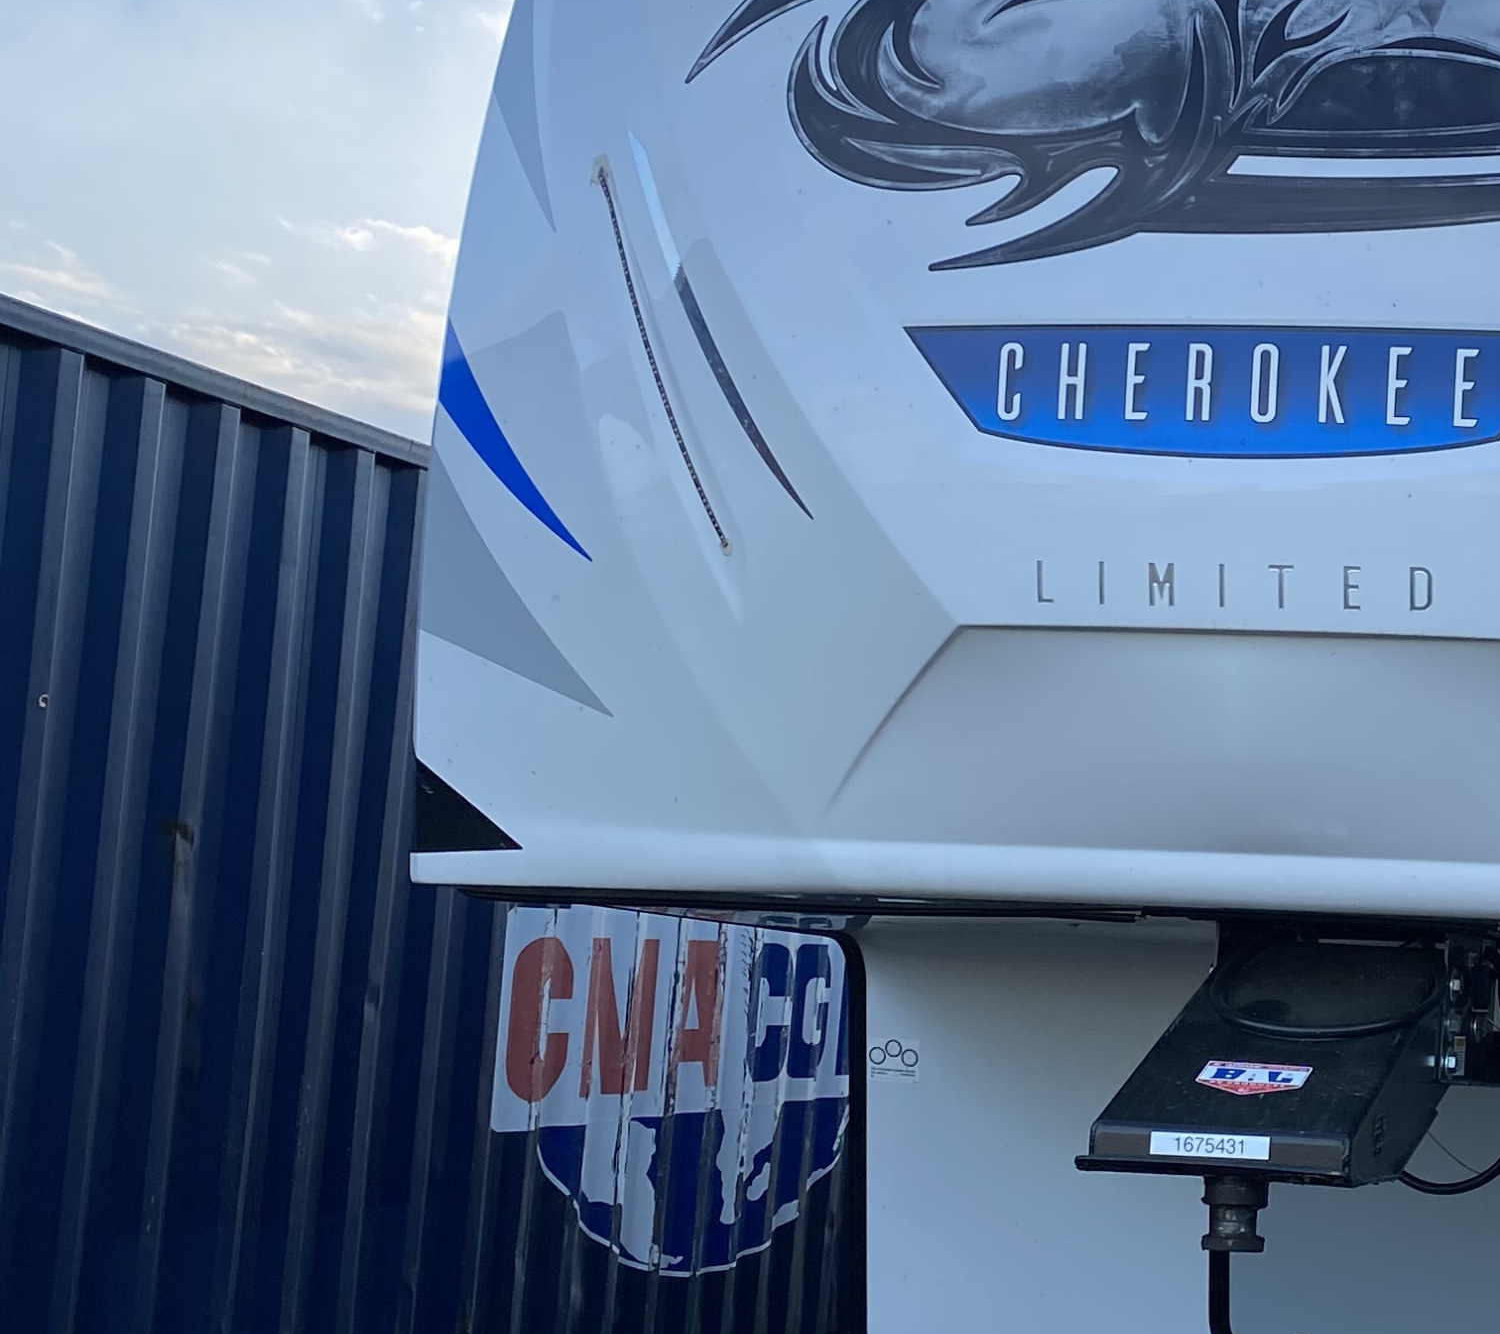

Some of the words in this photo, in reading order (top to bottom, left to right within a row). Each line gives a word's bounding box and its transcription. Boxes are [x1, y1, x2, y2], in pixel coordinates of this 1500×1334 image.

[997, 342, 1480, 428] CHEROKEE
[1037, 560, 1434, 611] LIMITED
[746, 942, 850, 1082] CG
[1174, 1135, 1244, 1155] 1675431
